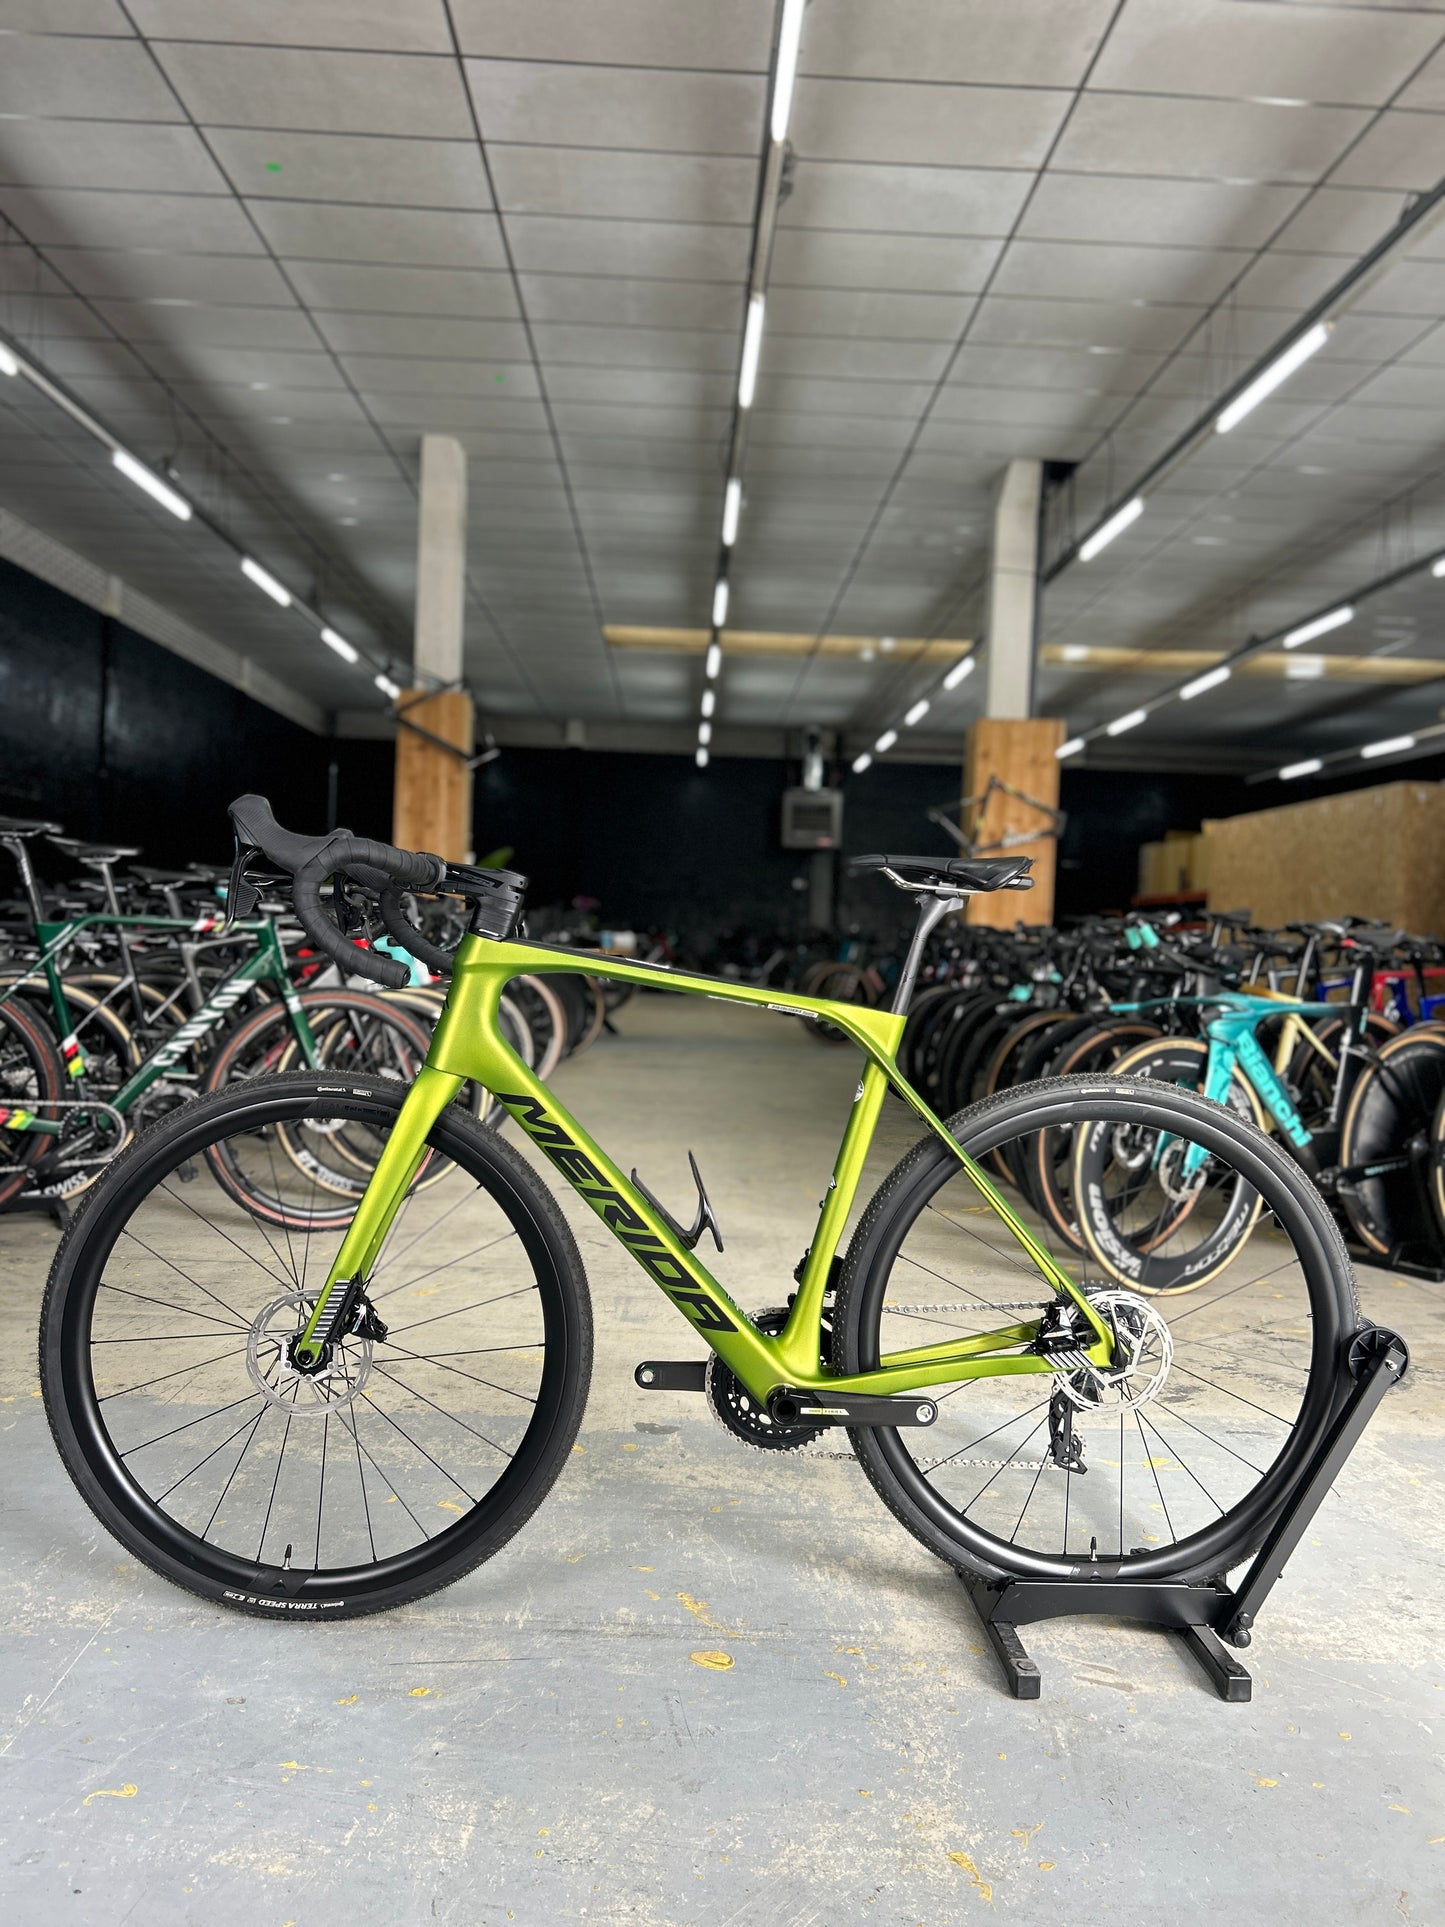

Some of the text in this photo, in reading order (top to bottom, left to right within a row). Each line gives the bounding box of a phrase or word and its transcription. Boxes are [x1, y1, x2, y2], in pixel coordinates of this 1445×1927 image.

[152, 978, 256, 1066] CANYON
[1236, 1029, 1313, 1148] Bianchi
[495, 1092, 740, 1333] MERIDA
[258, 1599, 287, 1609] SPEED
[288, 1602, 318, 1610] TERRA
